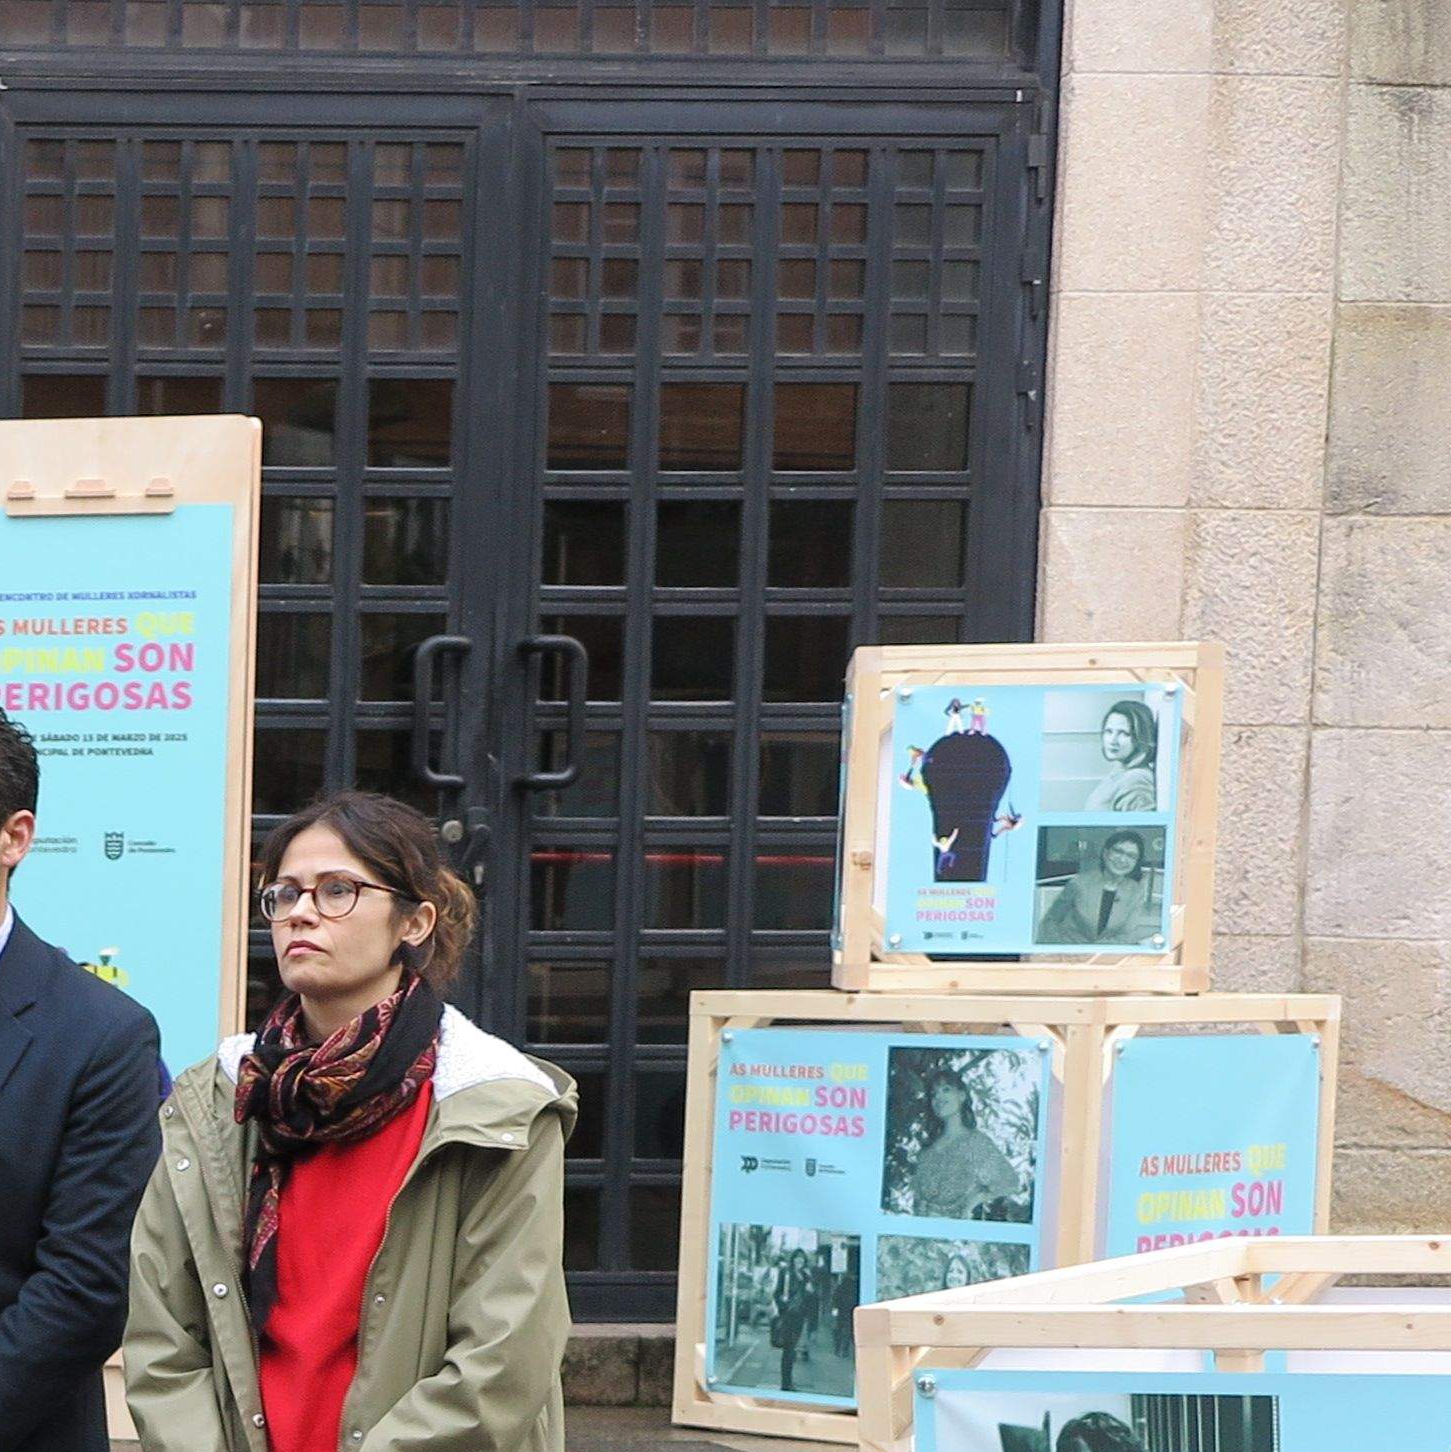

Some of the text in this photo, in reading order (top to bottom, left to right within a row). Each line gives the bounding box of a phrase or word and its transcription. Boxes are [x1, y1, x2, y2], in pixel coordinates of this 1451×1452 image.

[0, 592, 54, 601] ENCONTRO
[57, 592, 70, 601] DE
[72, 591, 125, 601] MULLERES
[127, 590, 197, 600] XORNALISTAS
[12, 618, 128, 636] MULLERES
[136, 612, 194, 639] QUE
[113, 642, 194, 673] SON
[40, 731, 80, 742] SÁBADO
[96, 733, 109, 742] DE
[111, 733, 146, 742] MARZO
[149, 733, 161, 742] DE
[72, 747, 85, 756] DE
[87, 747, 154, 756] PONTEVEDRA
[965, 897, 996, 909] SON
[916, 910, 995, 922] PERIGOSAS
[730, 1063, 747, 1076] AS
[750, 1064, 824, 1079] MULLERES
[814, 1086, 866, 1109] SON
[729, 1110, 865, 1138] PERIGOSAS
[1139, 1156, 1159, 1177] AS
[1163, 1152, 1242, 1176] MULLERES
[1231, 1180, 1283, 1218] SON
